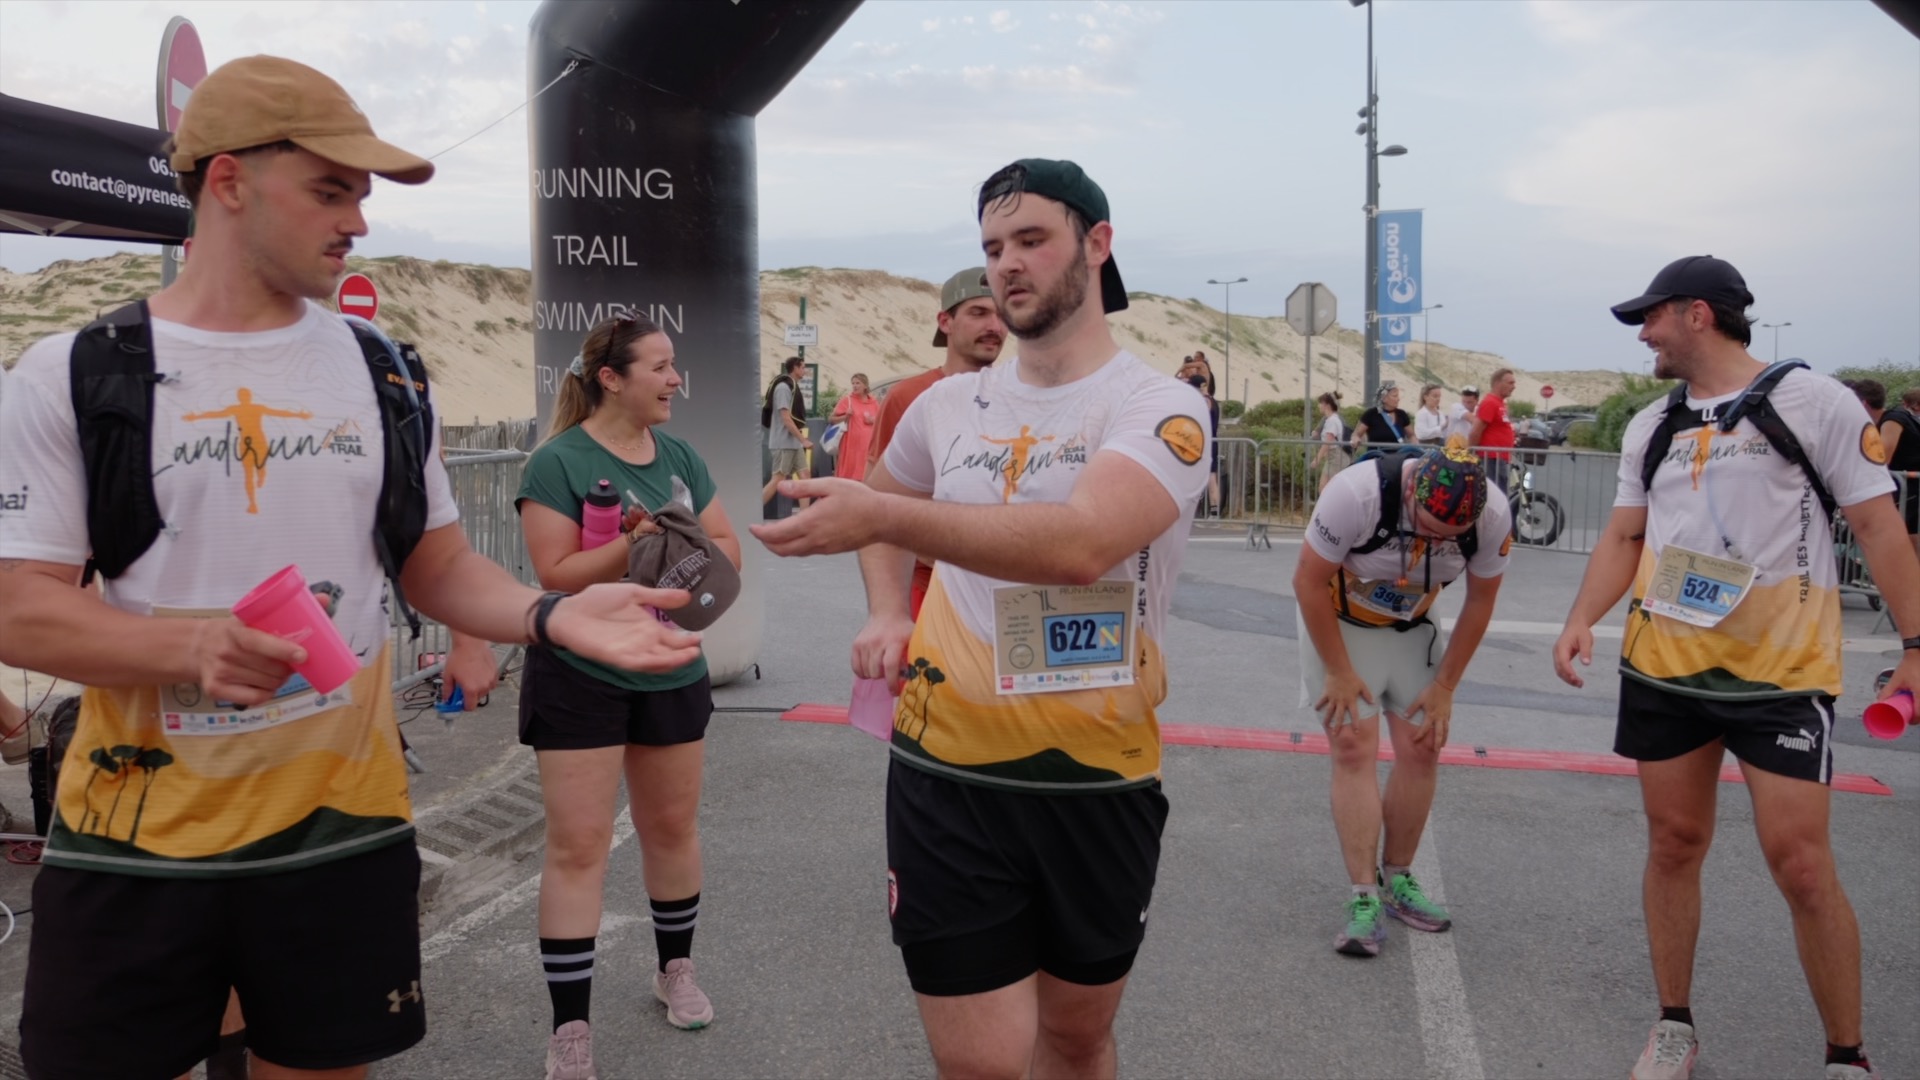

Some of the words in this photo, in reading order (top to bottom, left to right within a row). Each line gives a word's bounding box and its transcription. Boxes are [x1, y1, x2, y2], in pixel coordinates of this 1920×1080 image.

[533, 167, 673, 200] RUNNING
[552, 235, 638, 266] TRAIL
[329, 443, 367, 456] TRAIL
[1060, 453, 1088, 464] TRAIL
[1797, 545, 1809, 567] DES
[1095, 584, 1127, 595] LAND
[1684, 577, 1720, 604] 524
[1799, 570, 1810, 604] TRAIL
[1050, 619, 1097, 652] 622
[1776, 734, 1811, 752] PUMA
